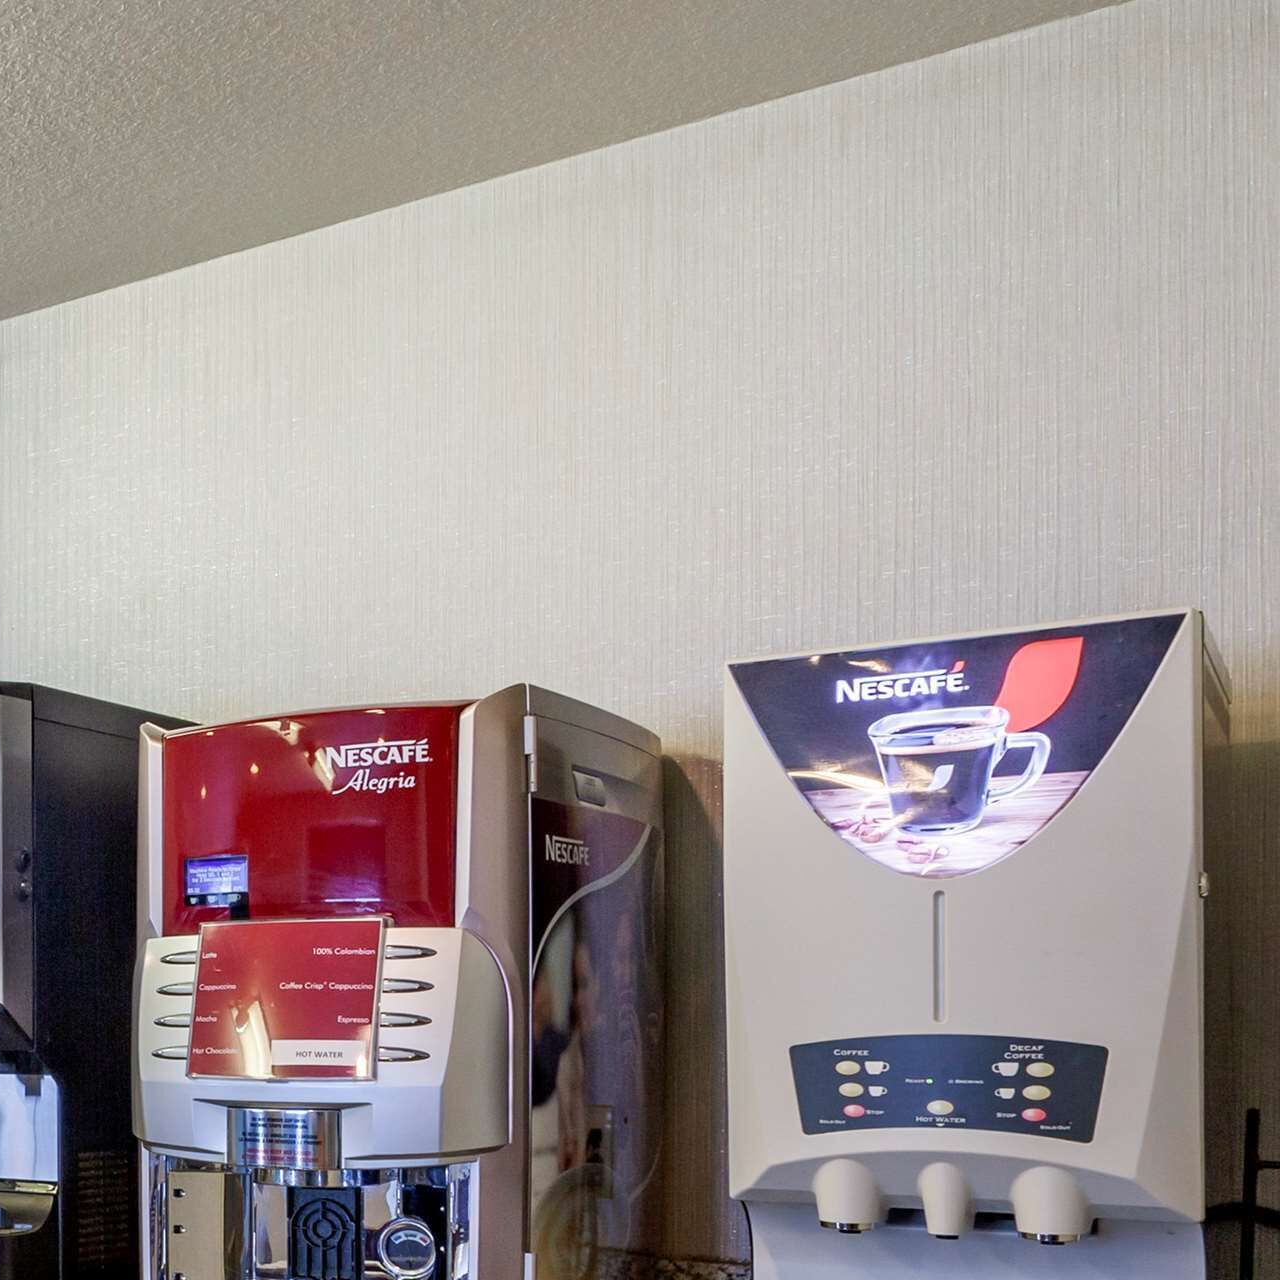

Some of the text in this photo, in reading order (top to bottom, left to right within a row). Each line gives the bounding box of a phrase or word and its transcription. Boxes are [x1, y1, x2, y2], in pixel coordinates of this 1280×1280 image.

[331, 769, 416, 795] Alegria
[202, 951, 217, 959] Latte
[312, 947, 376, 955] 100% Colombian
[199, 983, 237, 991] Cappuccino
[279, 982, 303, 990] Coffee
[329, 982, 374, 991] Cappuccino
[195, 1015, 218, 1023] Mocha
[337, 1015, 370, 1025] Espresso
[192, 1047, 239, 1055] Hot Chocola
[314, 1050, 343, 1059] WATER
